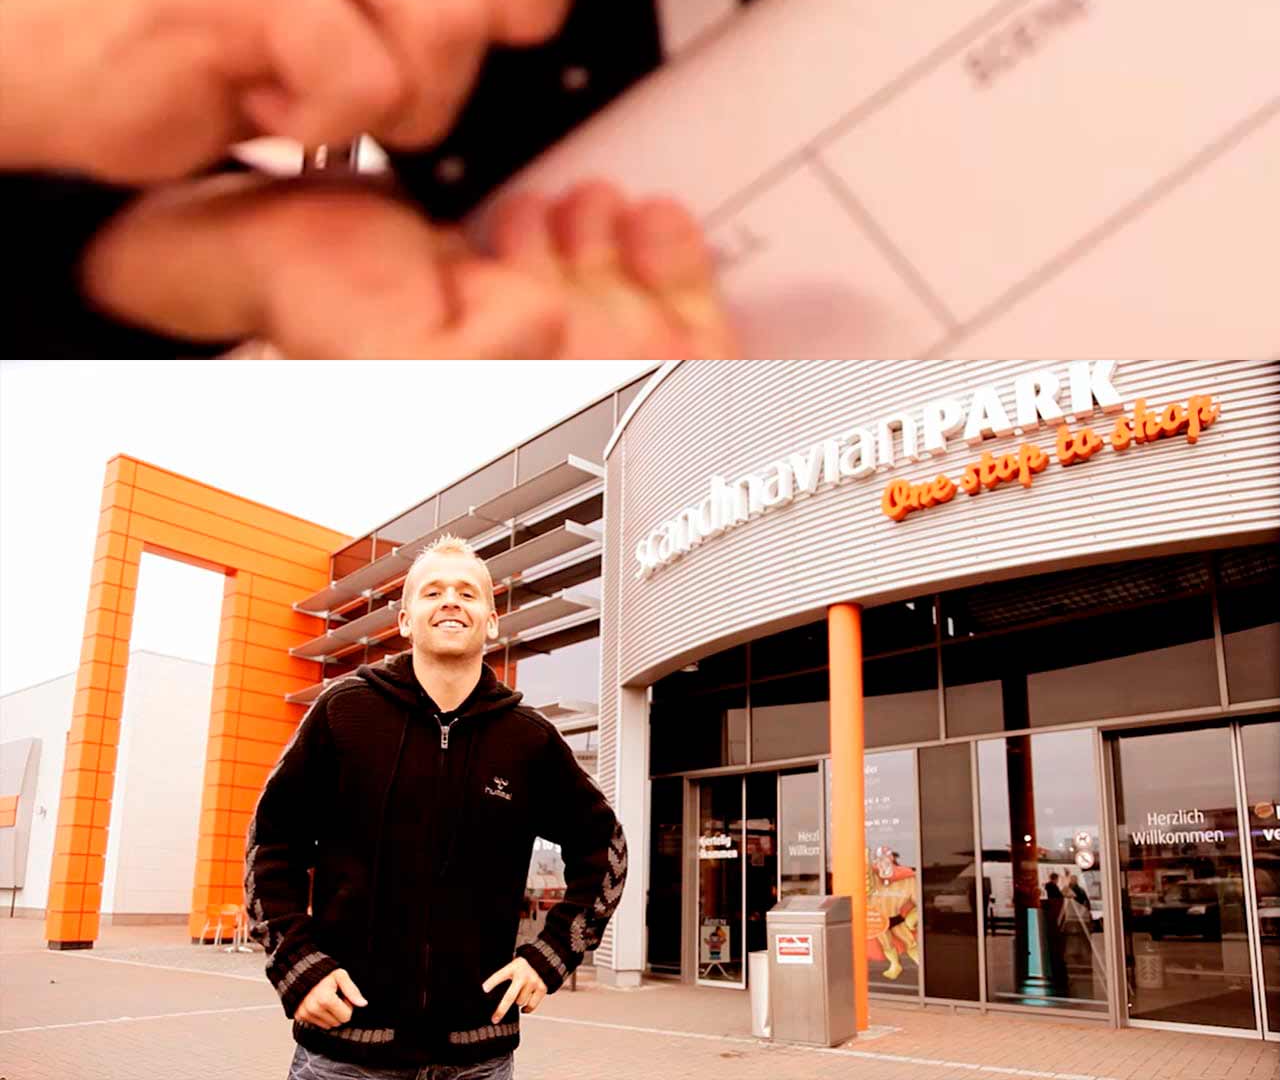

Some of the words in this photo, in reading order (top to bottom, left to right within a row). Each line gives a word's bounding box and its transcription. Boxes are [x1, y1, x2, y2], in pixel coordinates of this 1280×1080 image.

[634, 360, 1124, 580] scandinavianPARK
[881, 474, 957, 522] One
[961, 442, 1049, 497] stop
[1056, 424, 1103, 467] to
[1110, 394, 1221, 445] shop
[1132, 829, 1225, 845] Willkommen
[1147, 809, 1204, 826] Herzlich
